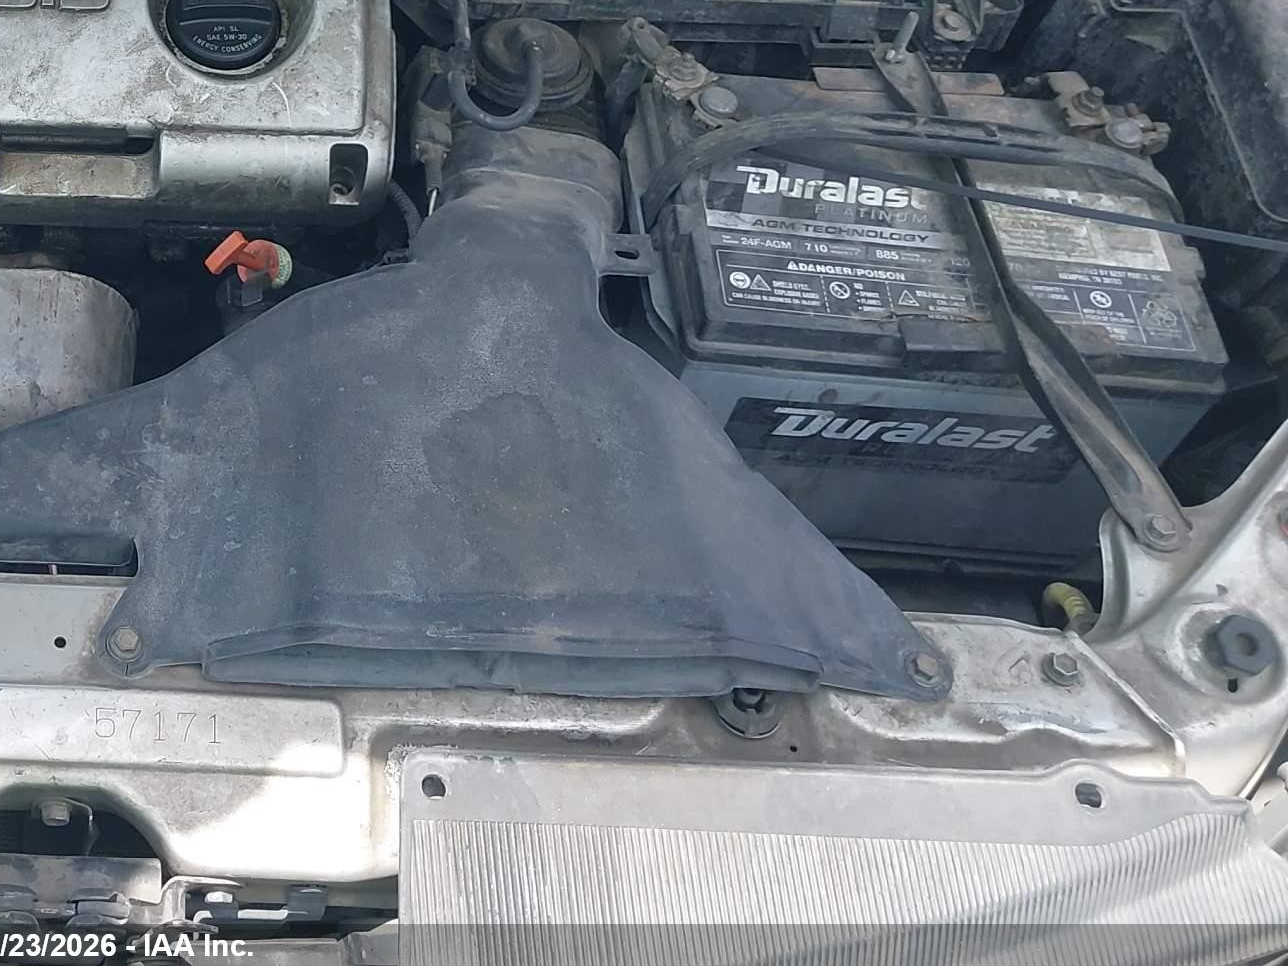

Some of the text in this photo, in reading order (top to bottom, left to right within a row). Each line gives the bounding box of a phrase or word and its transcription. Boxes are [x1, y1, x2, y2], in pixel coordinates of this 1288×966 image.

[192, 34, 263, 53] ENERGY CONSERVING
[206, 33, 248, 41] SAE 5W-30
[815, 203, 928, 225] PLATINUM
[752, 218, 929, 243] AGM TECHNOLOGY
[740, 237, 792, 250] 24F-AGM
[804, 242, 828, 253] 710
[875, 249, 899, 260] 885
[798, 263, 906, 281] DANGER/POISON
[771, 406, 1057, 453] Duralast
[94, 706, 223, 745] 57171
